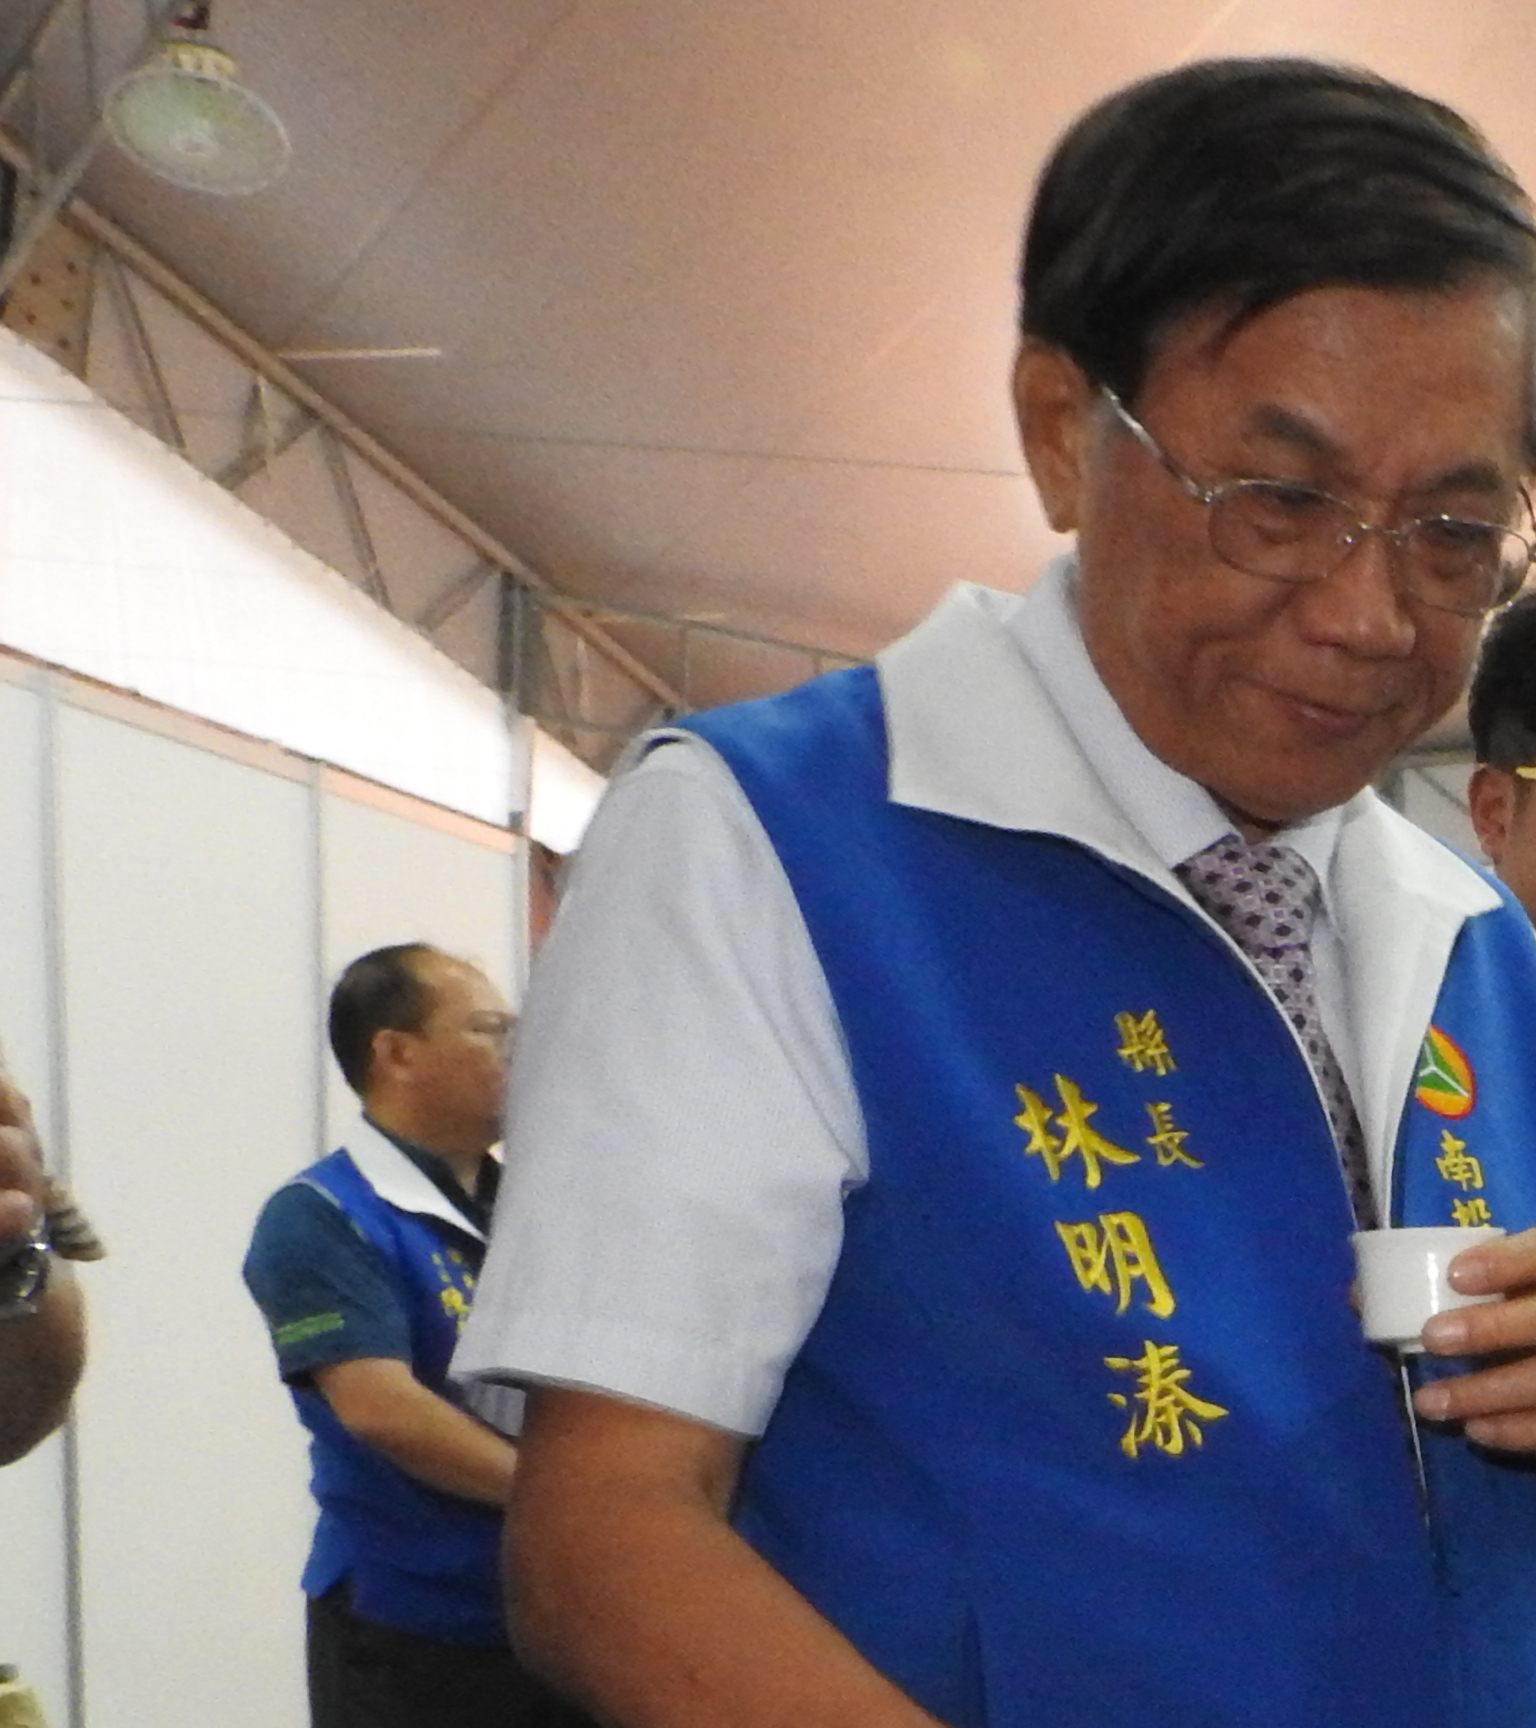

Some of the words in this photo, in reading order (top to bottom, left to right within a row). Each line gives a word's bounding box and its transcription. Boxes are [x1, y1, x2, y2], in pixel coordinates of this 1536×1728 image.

[1115, 1008, 1206, 1169] 縣長
[1012, 1072, 1231, 1460] 林明溱
